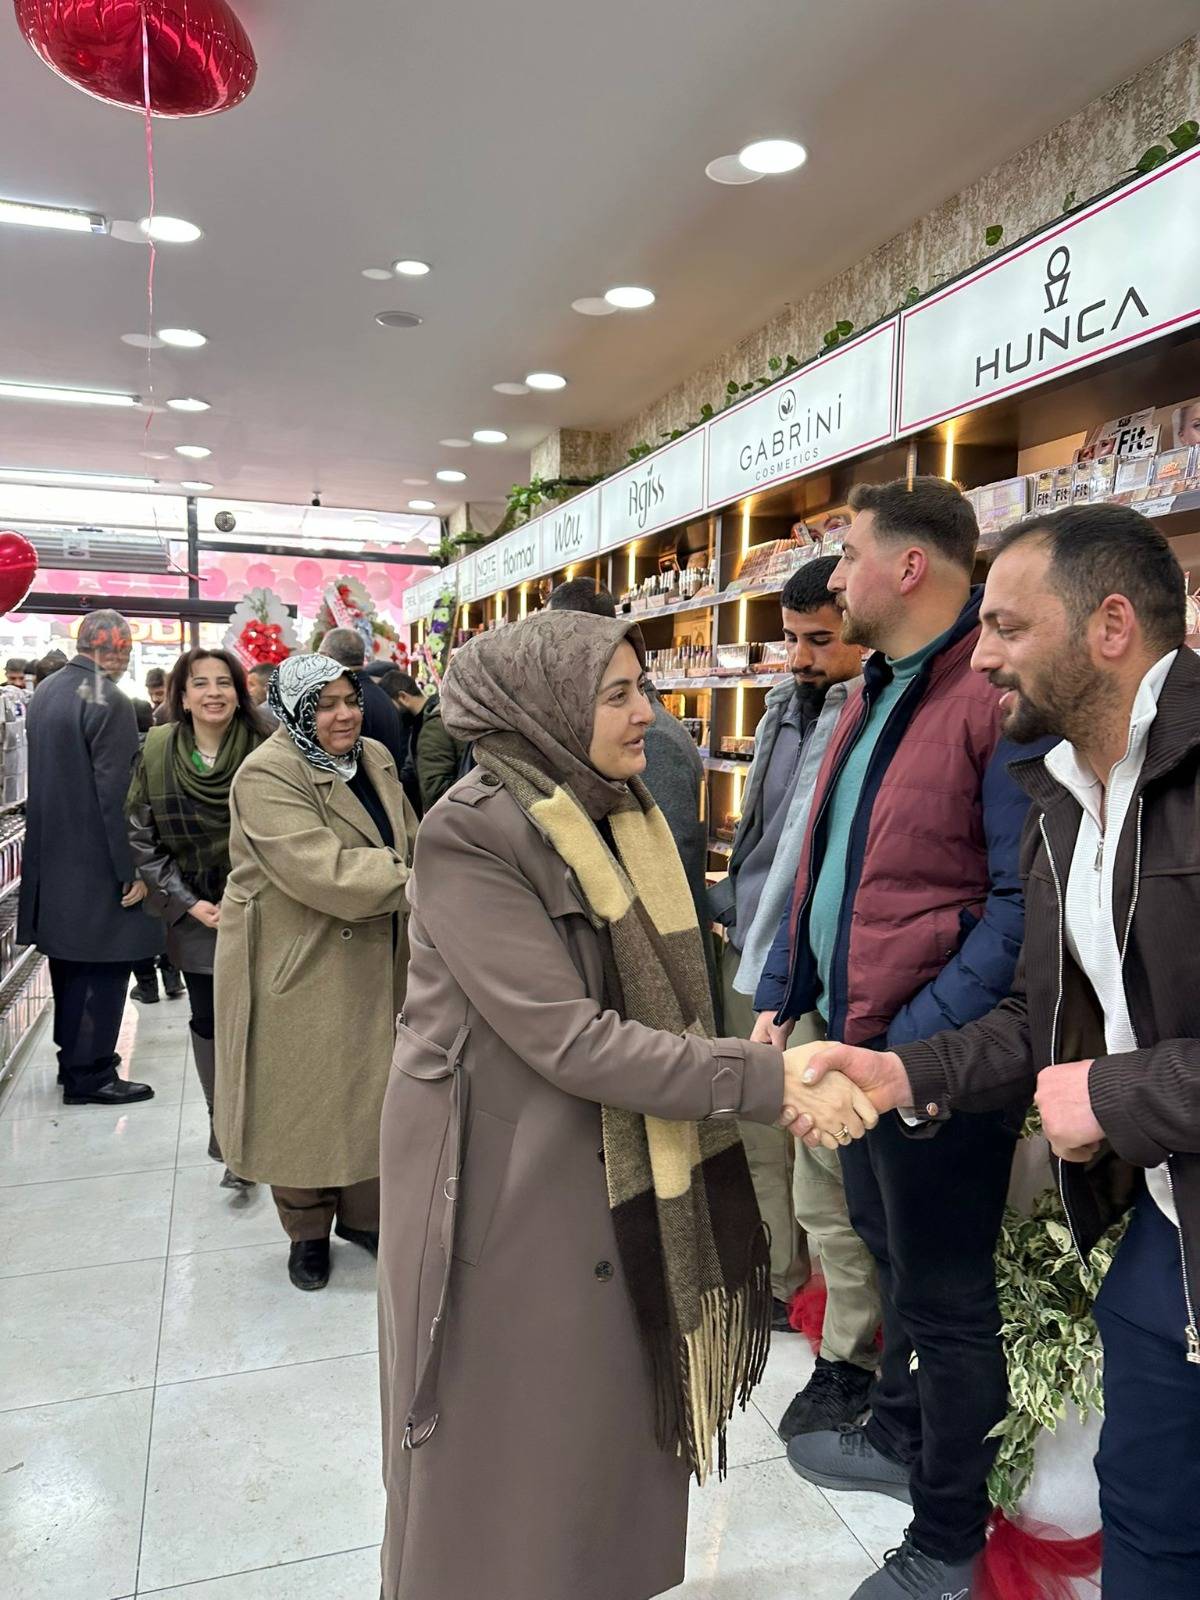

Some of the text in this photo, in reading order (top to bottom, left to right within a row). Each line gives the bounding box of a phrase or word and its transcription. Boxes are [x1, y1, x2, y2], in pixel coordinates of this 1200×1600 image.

[975, 286, 1149, 387] HUNCA
[755, 447, 819, 481] COSMETICS
[503, 543, 536, 577] flormar
